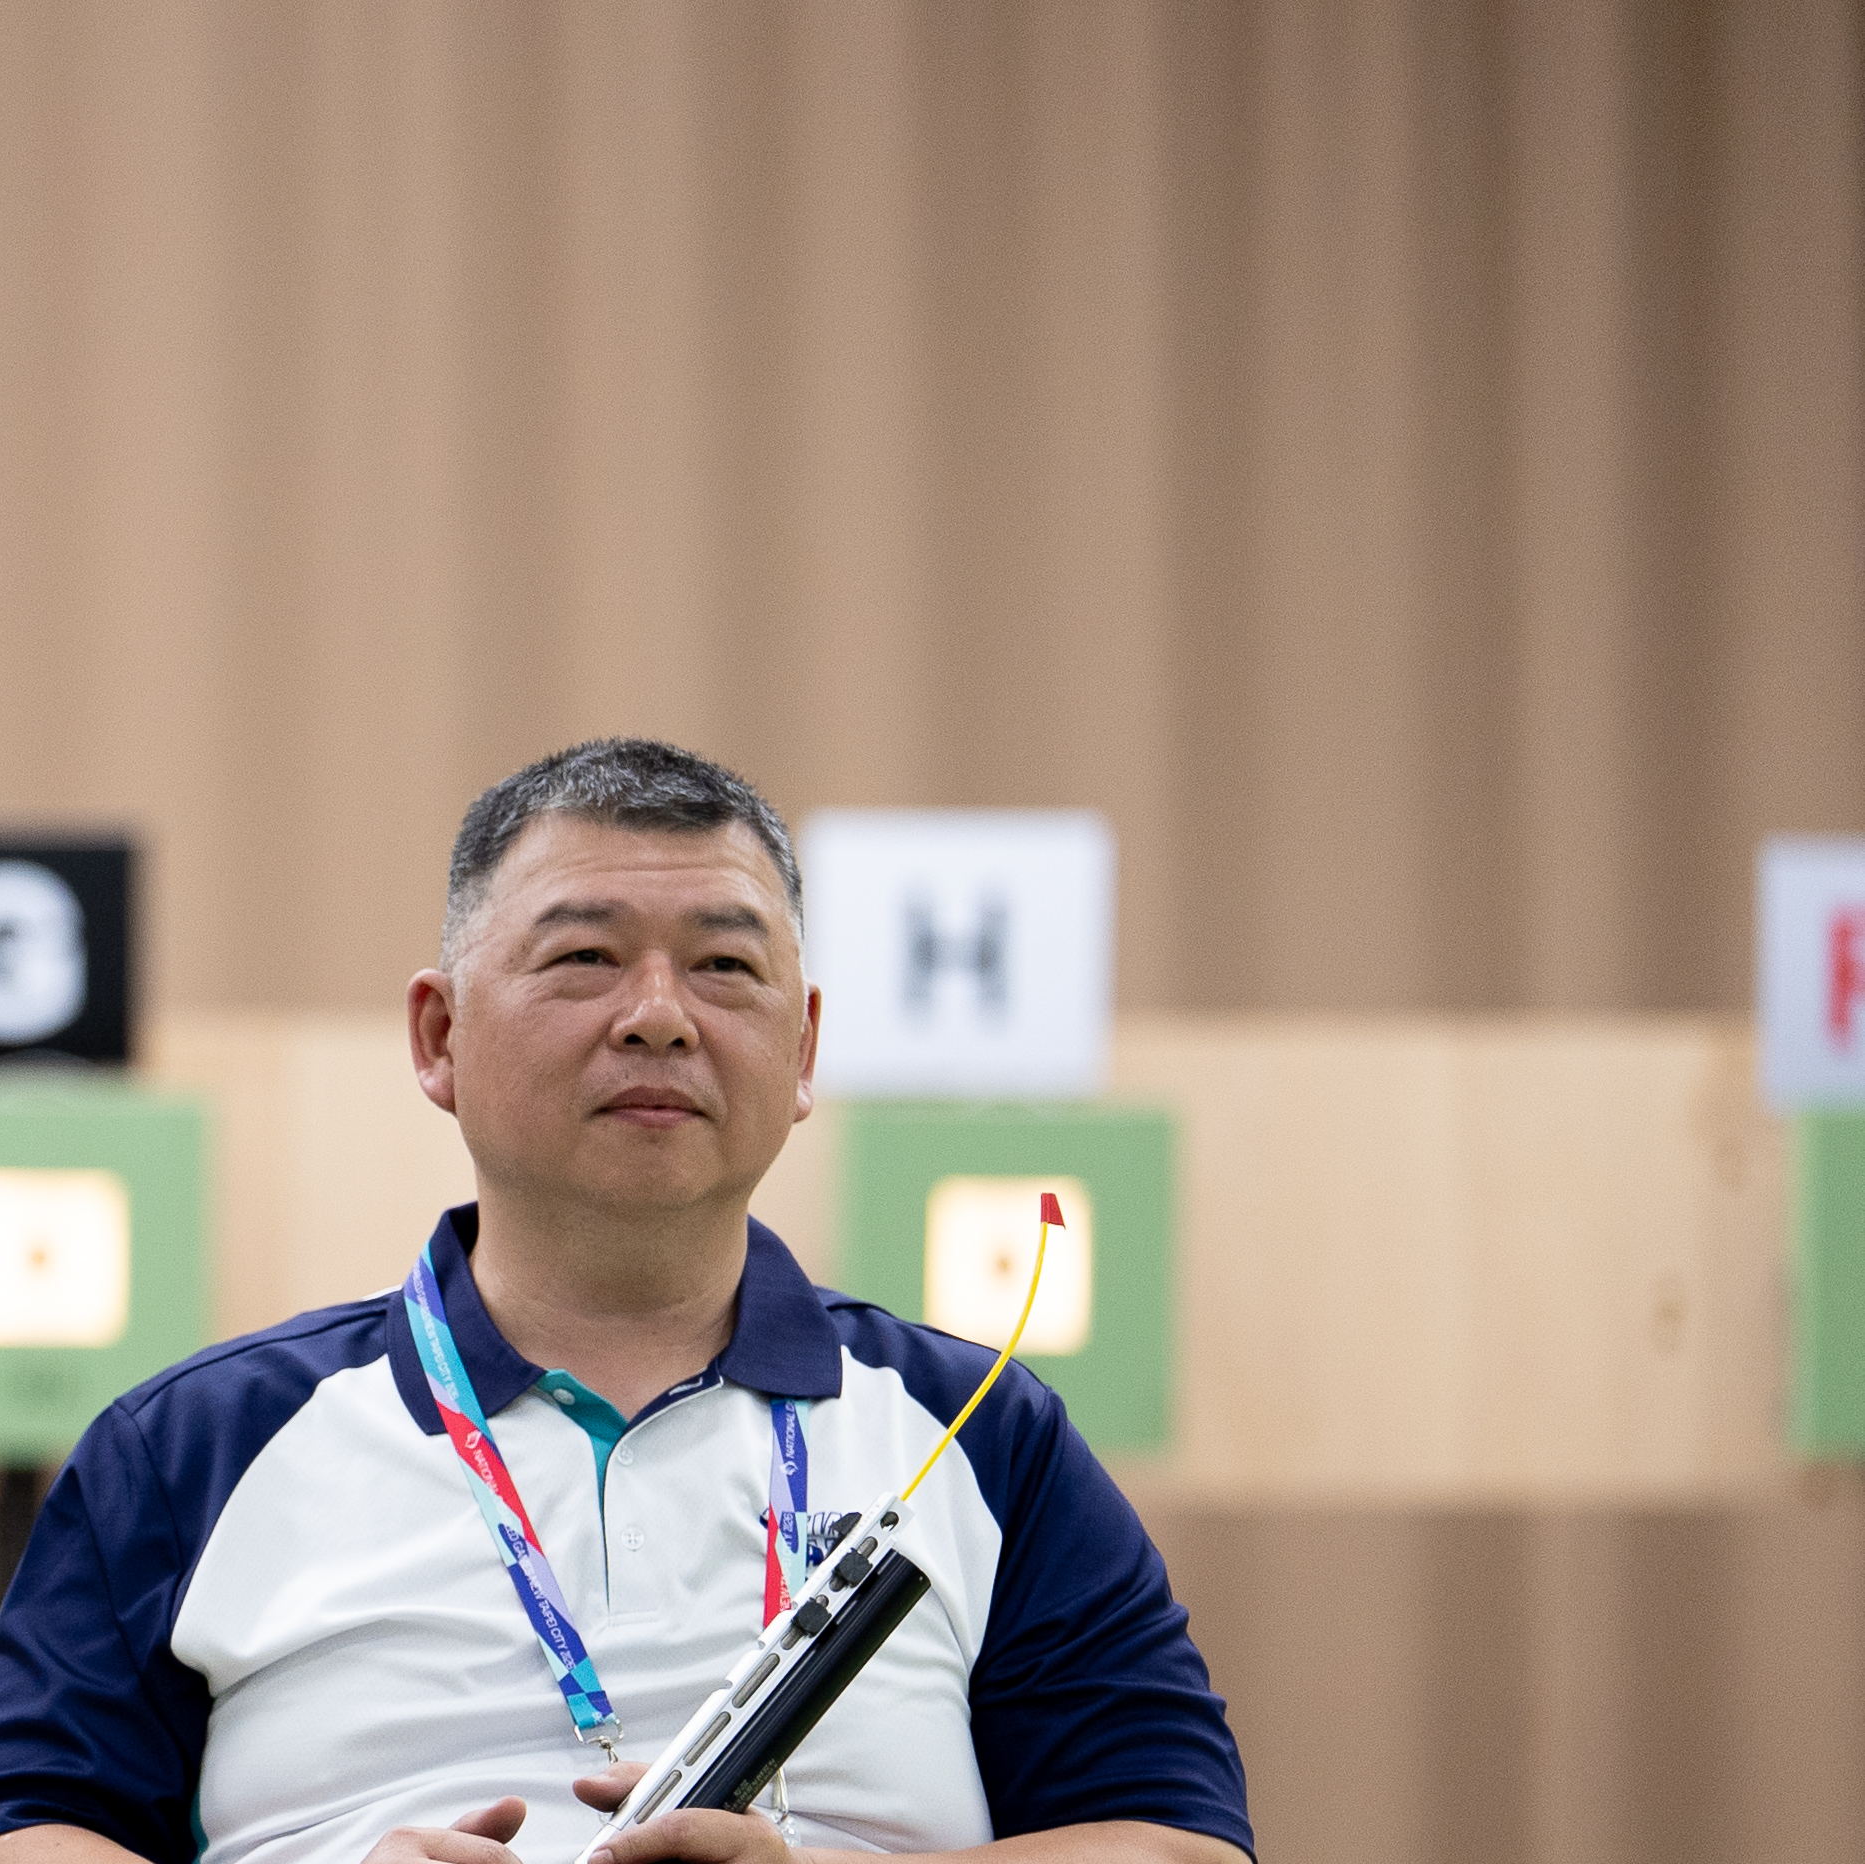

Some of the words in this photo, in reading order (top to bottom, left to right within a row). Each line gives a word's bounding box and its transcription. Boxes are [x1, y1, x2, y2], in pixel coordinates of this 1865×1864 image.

[898, 877, 1016, 1035] H
[785, 1413, 796, 1458] NATIONAL
[536, 1598, 558, 1629] TAIPEI
[548, 1625, 568, 1652] CITY
